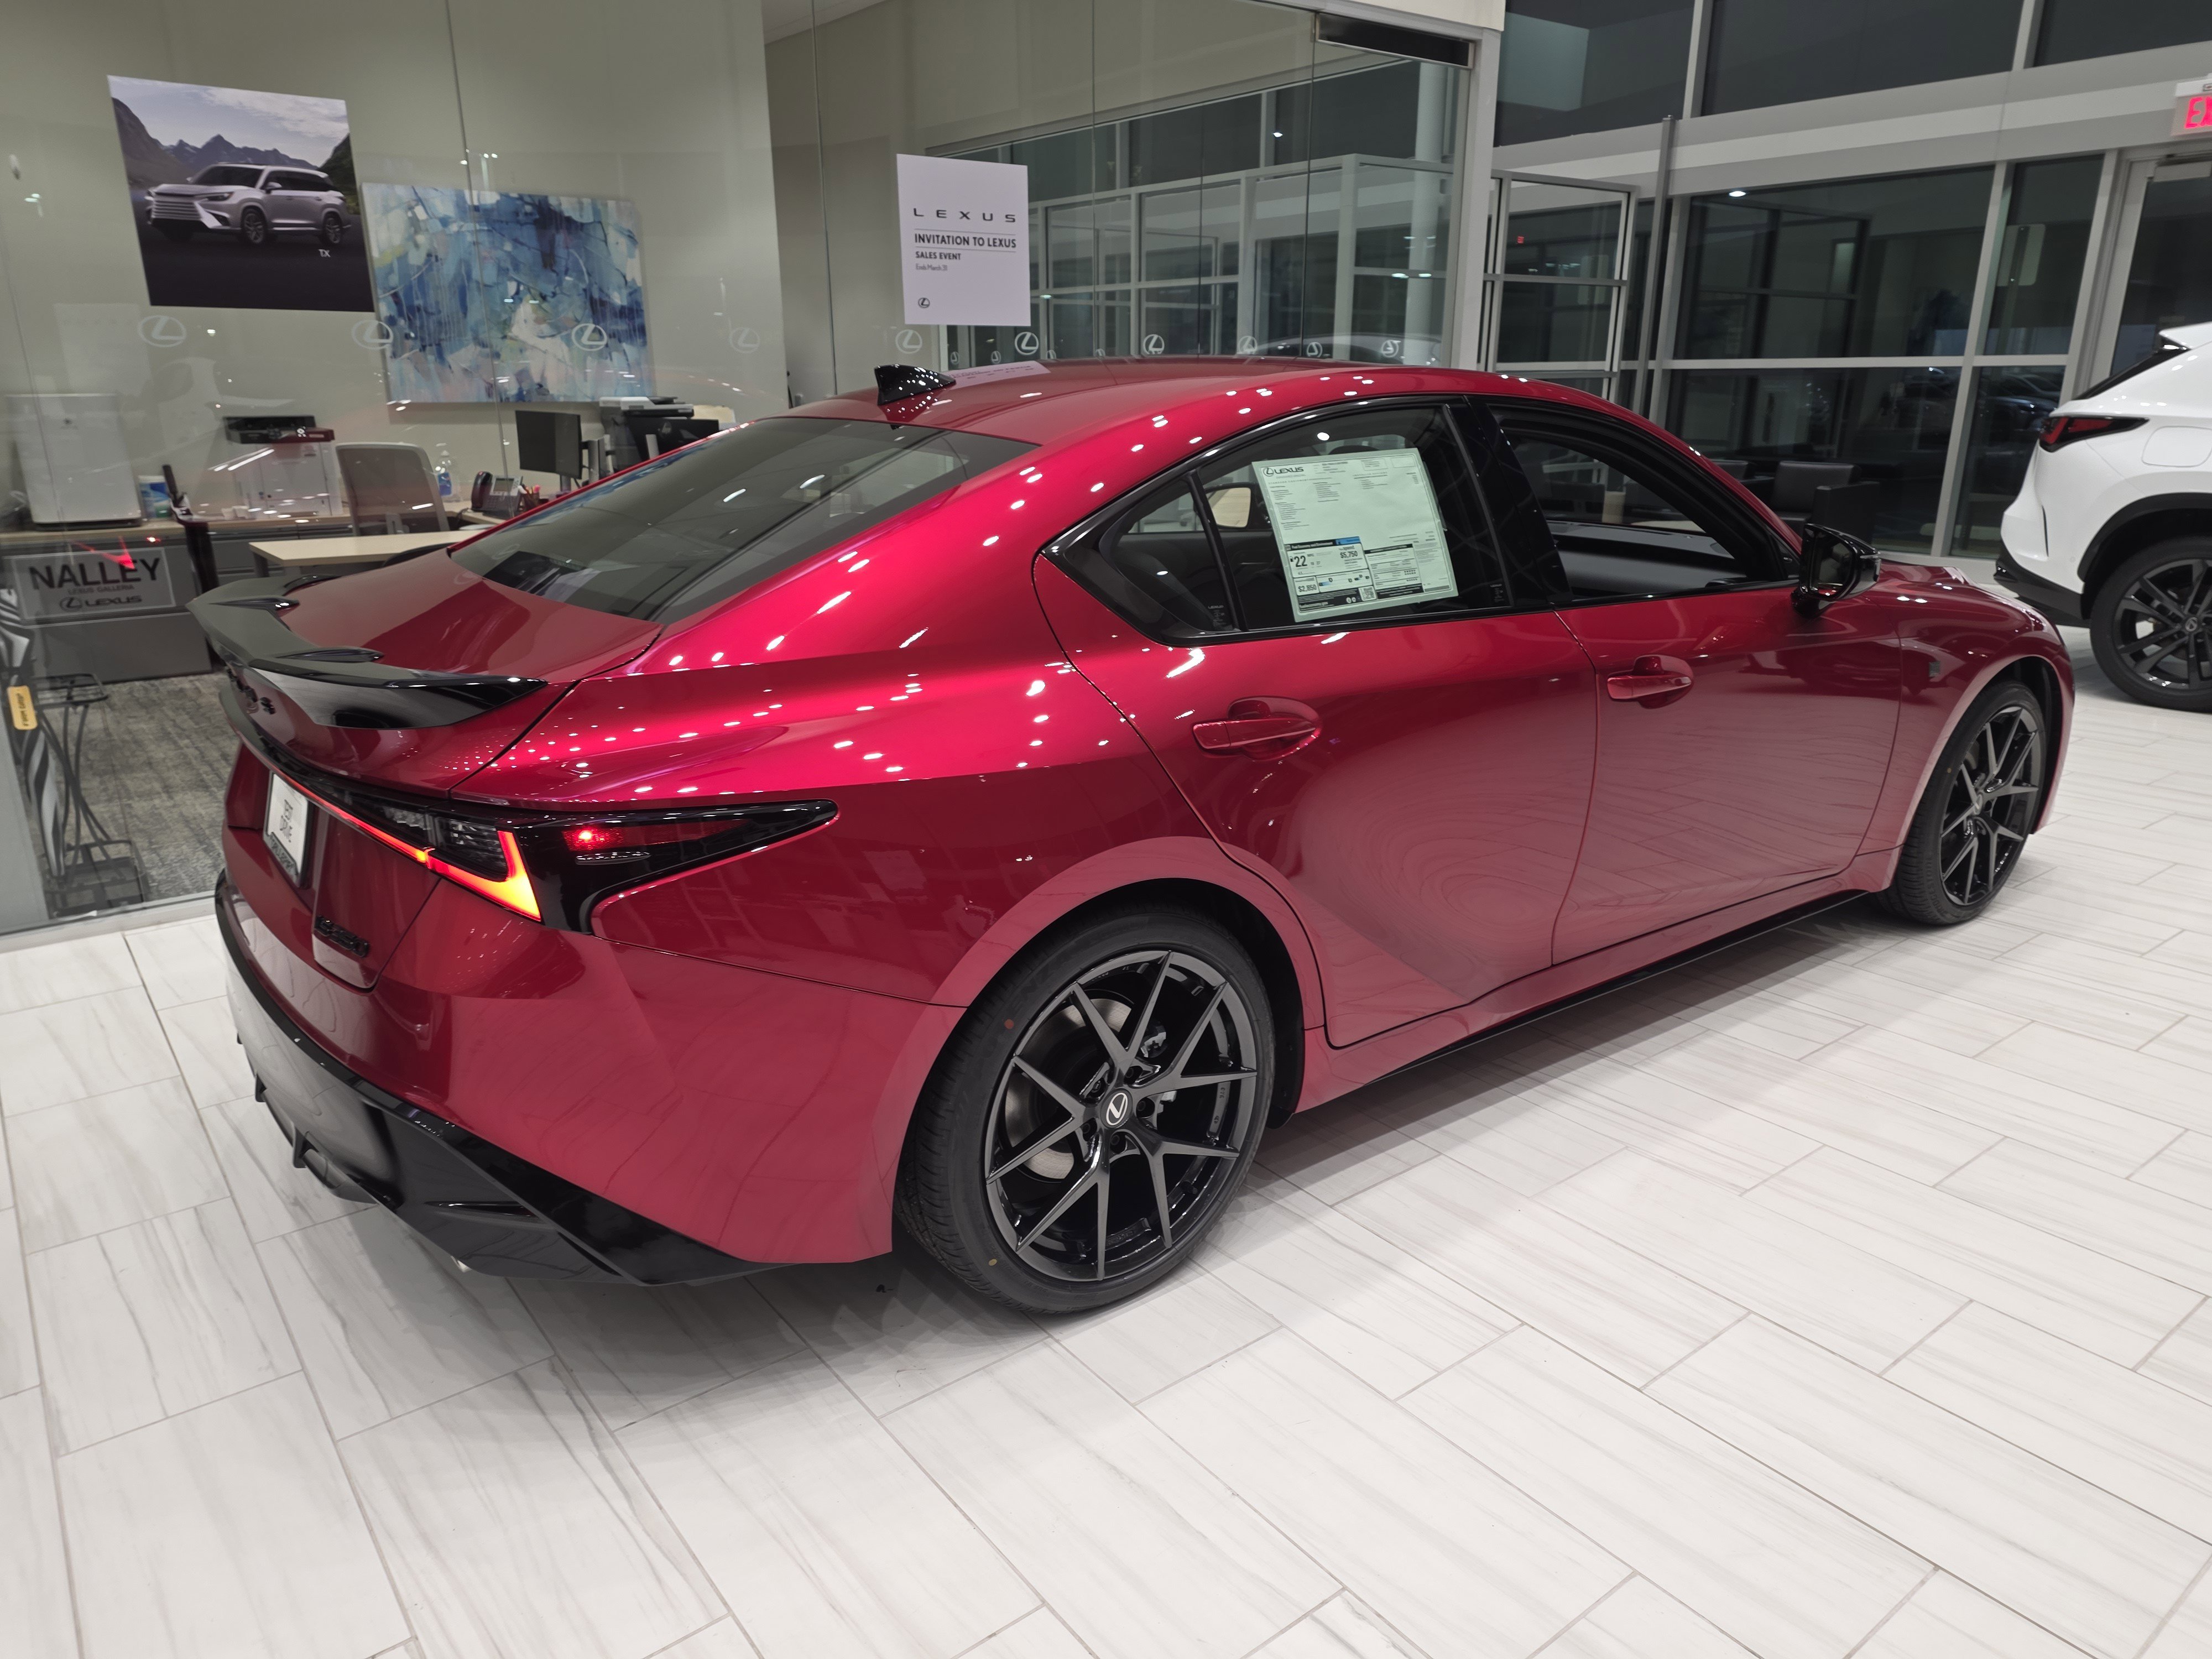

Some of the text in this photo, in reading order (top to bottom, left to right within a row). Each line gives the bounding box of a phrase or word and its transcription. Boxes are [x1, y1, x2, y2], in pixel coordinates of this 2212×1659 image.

[914, 208, 1015, 222] LEXUS
[914, 233, 1016, 248] INVITATION TO LEXUS
[915, 251, 961, 260] SALES EVENT
[1294, 555, 1307, 567] 22
[29, 557, 160, 590] NALLEY
[85, 596, 142, 607] LEXUS
